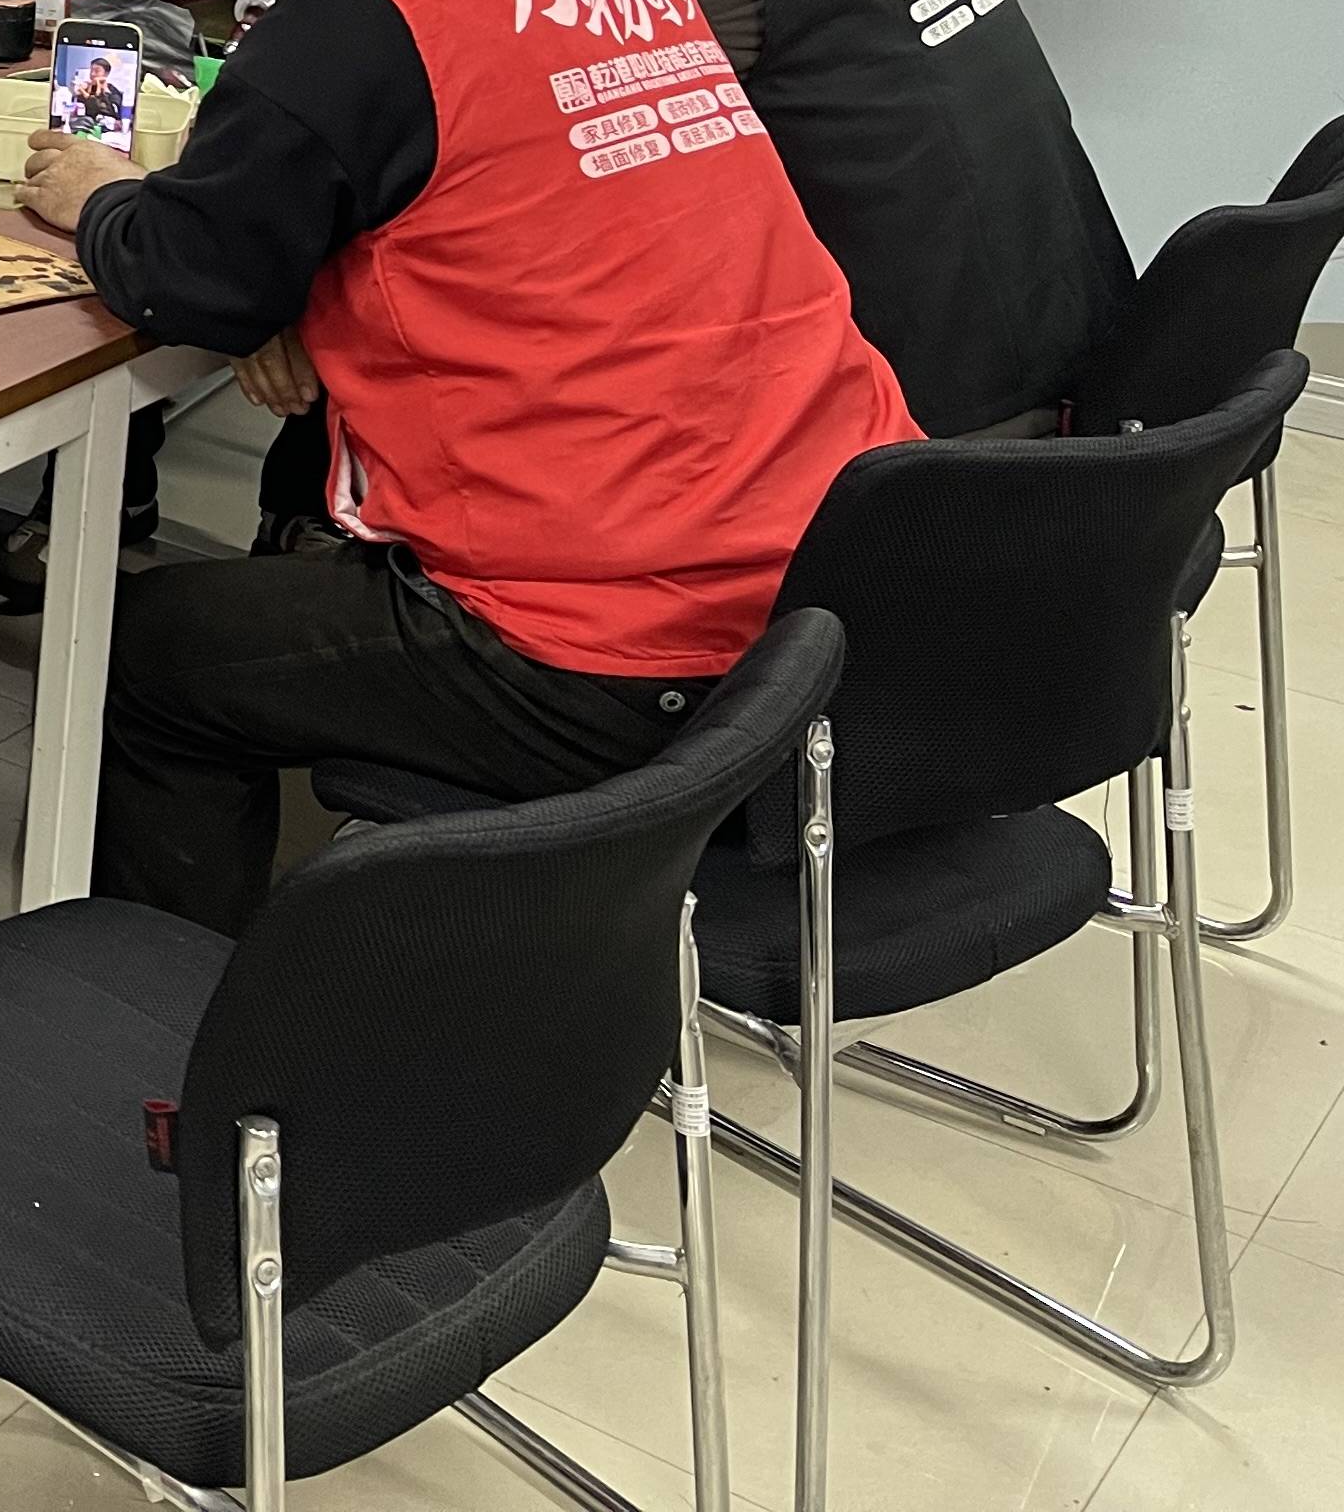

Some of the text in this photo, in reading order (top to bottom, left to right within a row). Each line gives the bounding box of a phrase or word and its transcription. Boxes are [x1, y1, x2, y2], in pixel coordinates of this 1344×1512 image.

[581, 110, 651, 145] 家具修复
[592, 139, 662, 172] 墙面修复
